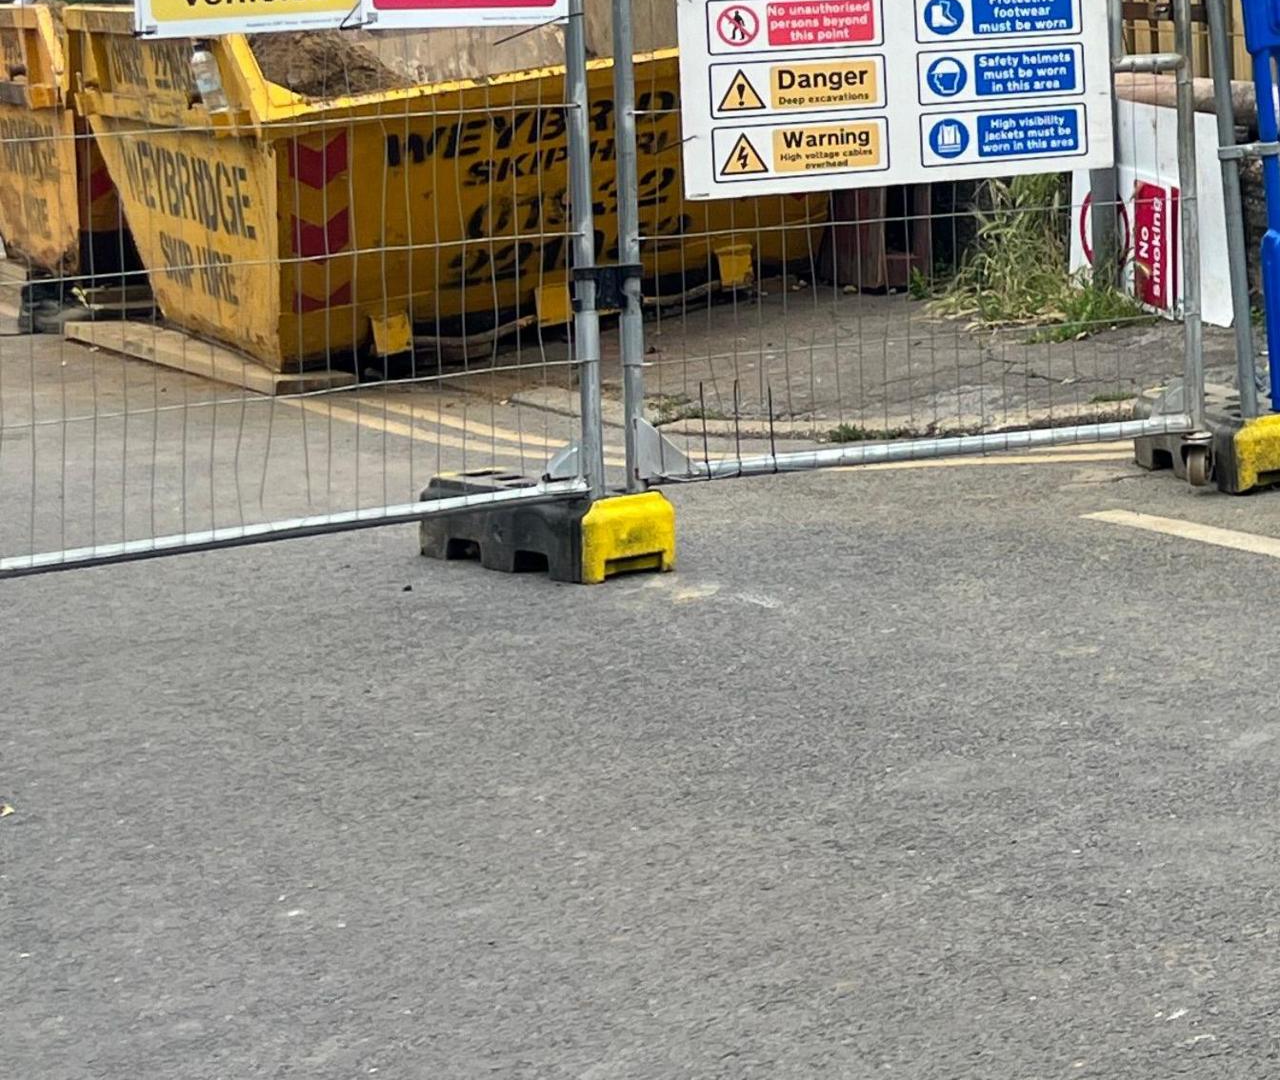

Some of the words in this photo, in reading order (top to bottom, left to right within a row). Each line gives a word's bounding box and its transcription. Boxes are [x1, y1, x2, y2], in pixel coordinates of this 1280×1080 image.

[767, 5, 785, 17] No
[789, 1, 870, 16] unauthorised
[993, 6, 1051, 18] footwear
[770, 17, 820, 31] persons
[823, 15, 868, 28] beyond
[979, 20, 1012, 33] must
[1015, 19, 1031, 31] be
[1035, 19, 1067, 30] worn
[790, 30, 814, 41] this
[817, 28, 850, 41] point
[979, 56, 1019, 69] Safety
[1022, 52, 1071, 65] helmets
[778, 69, 868, 90] Danger
[983, 69, 1014, 80] must
[1018, 67, 1033, 78] be
[1036, 66, 1067, 77] worn
[991, 81, 1003, 92] in
[1007, 80, 1030, 92] this
[1033, 80, 1060, 90] area
[779, 95, 805, 106] Deep
[808, 92, 869, 104] excavations
[783, 128, 870, 149] Warning
[780, 151, 801, 163] High
[805, 150, 840, 161] voltage
[842, 147, 872, 158] cables
[805, 158, 848, 170] overhead
[119, 136, 256, 240] WEYBRIDGE
[1139, 226, 1149, 258] No
[1152, 197, 1163, 297] smoking
[159, 231, 195, 288] SKIP
[197, 246, 241, 306] HIRE
